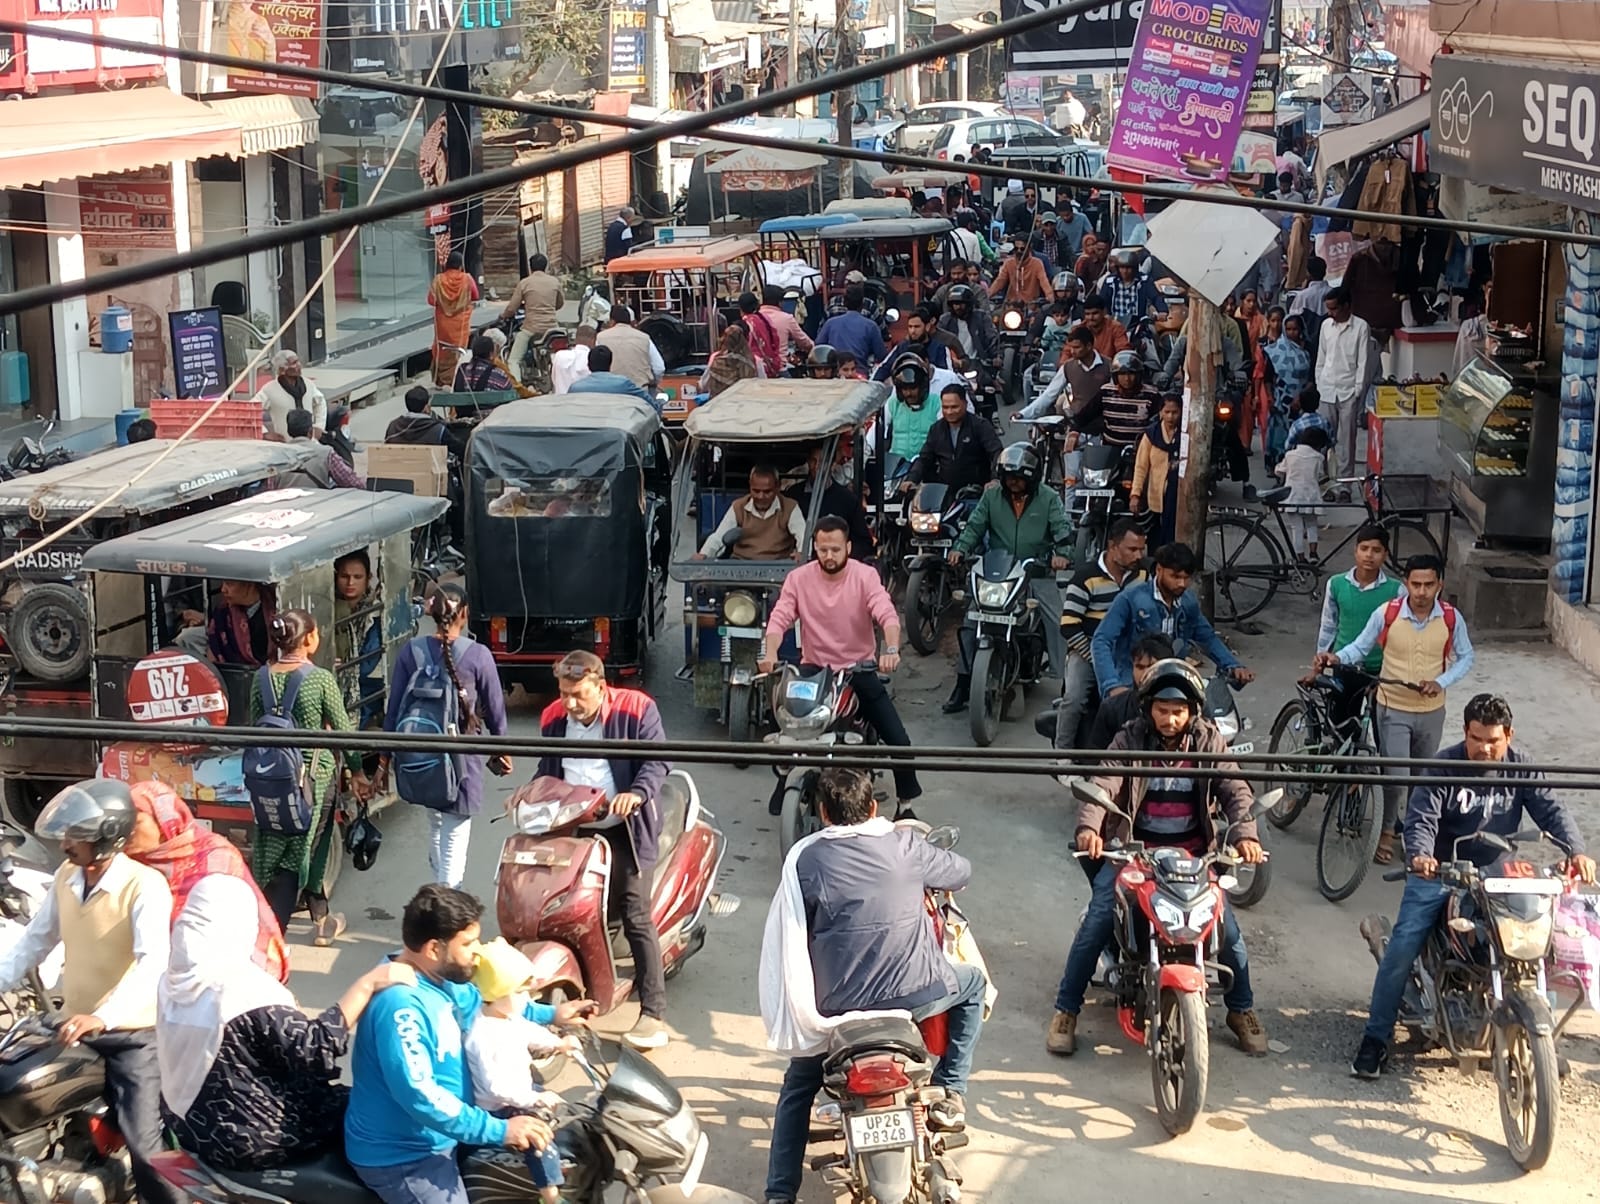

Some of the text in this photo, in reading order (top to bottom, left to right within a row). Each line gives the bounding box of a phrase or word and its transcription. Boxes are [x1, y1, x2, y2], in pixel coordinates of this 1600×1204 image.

[1150, 0, 1260, 38] MODERN
[1151, 22, 1249, 55] CROCKERIES
[1541, 166, 1571, 194] MEN'S
[147, 665, 189, 700] 249
